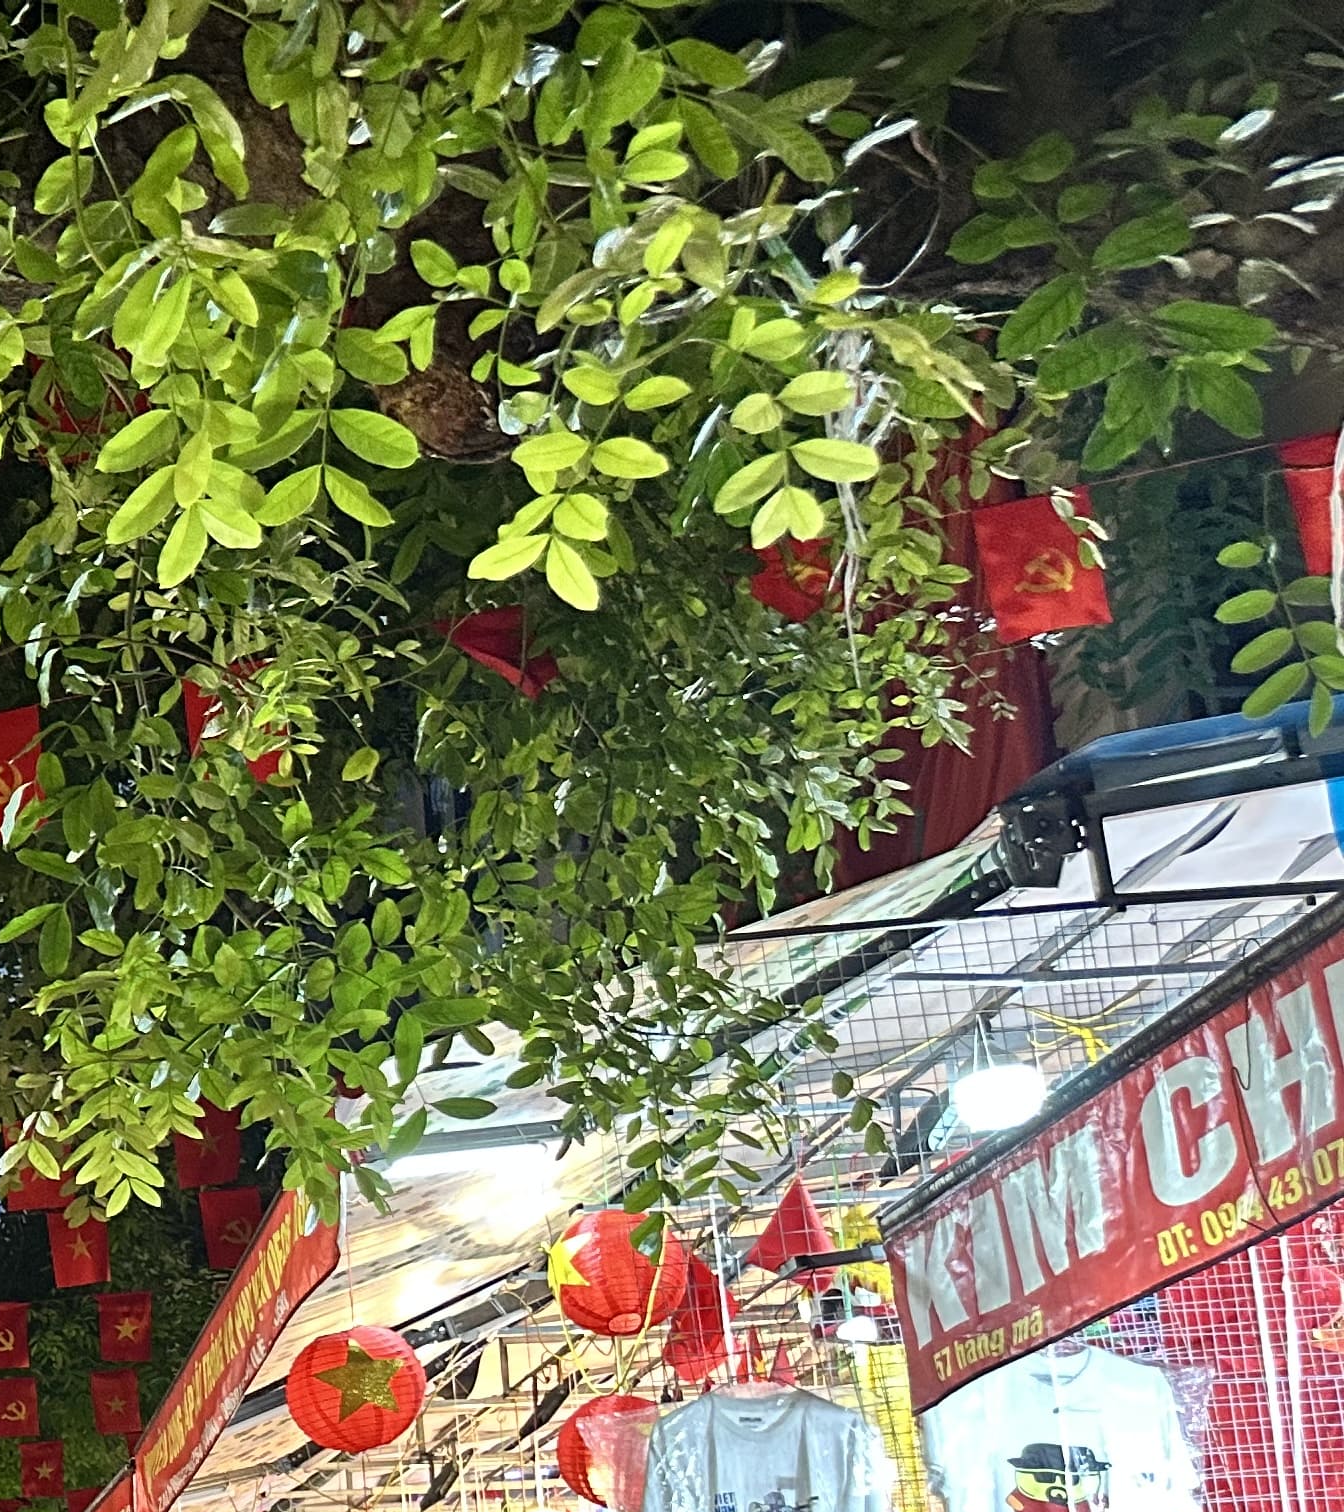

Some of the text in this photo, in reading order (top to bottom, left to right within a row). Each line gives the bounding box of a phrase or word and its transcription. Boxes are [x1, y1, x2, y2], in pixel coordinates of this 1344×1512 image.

[904, 1124, 1107, 1350] KIM
[933, 1346, 952, 1382] 57
[1012, 1304, 1044, 1345] mã
